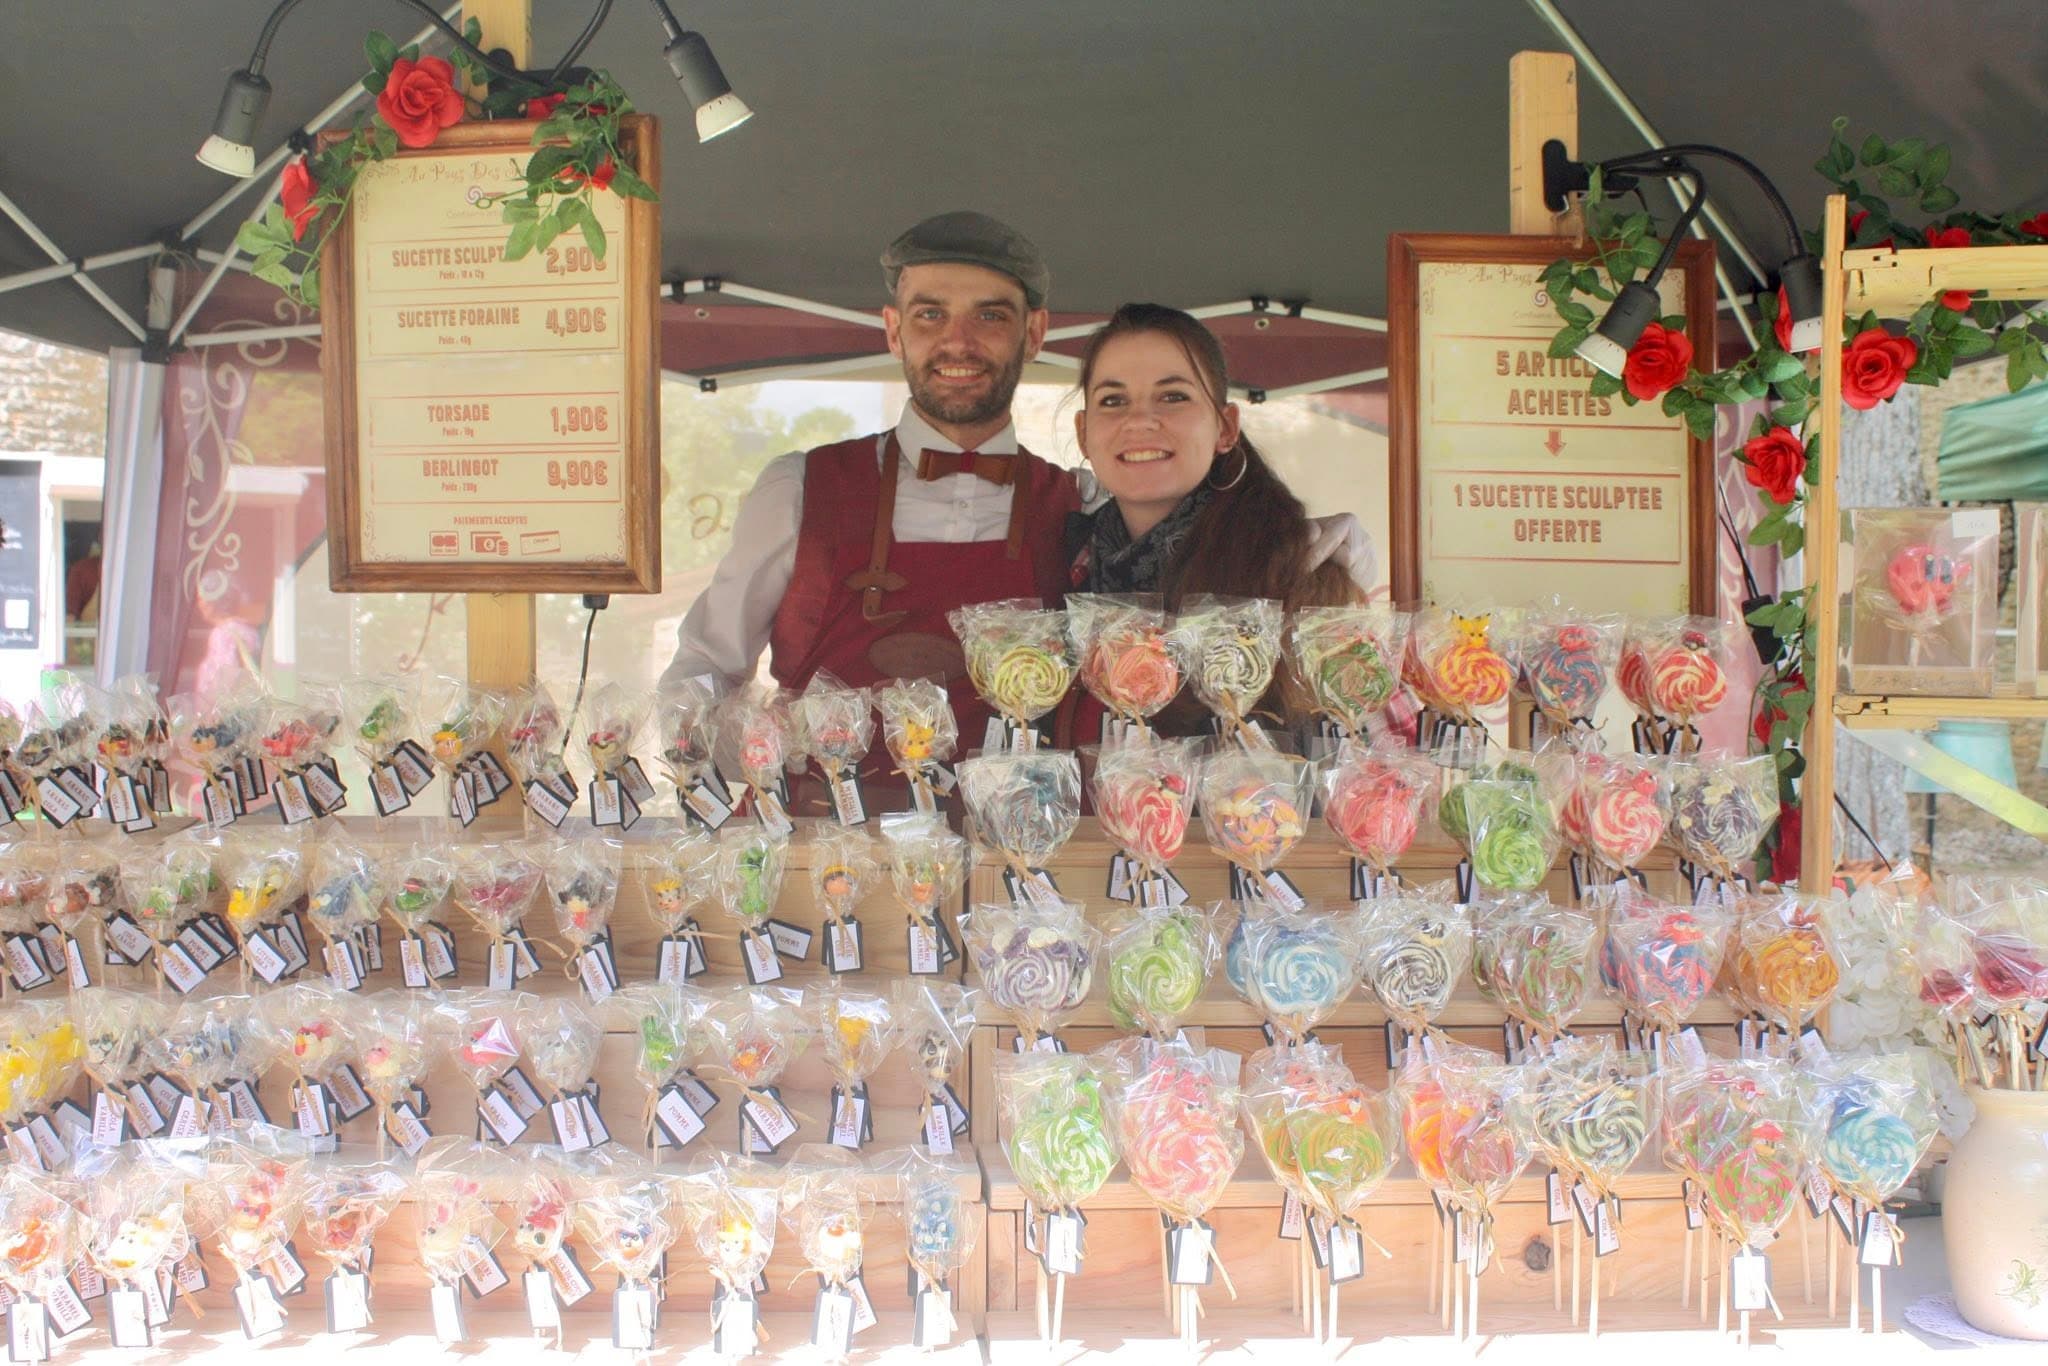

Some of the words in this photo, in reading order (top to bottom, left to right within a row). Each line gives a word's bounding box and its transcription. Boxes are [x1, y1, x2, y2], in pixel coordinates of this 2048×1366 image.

[392, 248, 451, 267] SUCETTE
[454, 245, 505, 265] SCULPT
[398, 309, 457, 328] SUCETTE
[459, 307, 520, 326] FORAINE
[546, 307, 608, 338] 4,90€
[1496, 351, 1510, 376] 5
[1515, 351, 1595, 378] ARTICL
[427, 404, 490, 423] TORSADE
[1507, 389, 1612, 417] ACHETES
[551, 406, 608, 436] 1,90€
[422, 458, 499, 477] BERLINGOT
[547, 460, 608, 490] 9,90€
[1454, 484, 1463, 507] 1
[1468, 484, 1558, 509] SUCETTE
[1563, 485, 1663, 510] SCULPTEE
[1514, 518, 1602, 543] OFFERTE
[97, 1105, 108, 1137] VANILLE
[666, 1104, 691, 1129] POMME
[48, 1289, 73, 1323] VANILLE
[54, 1282, 81, 1320] CARAMEL
